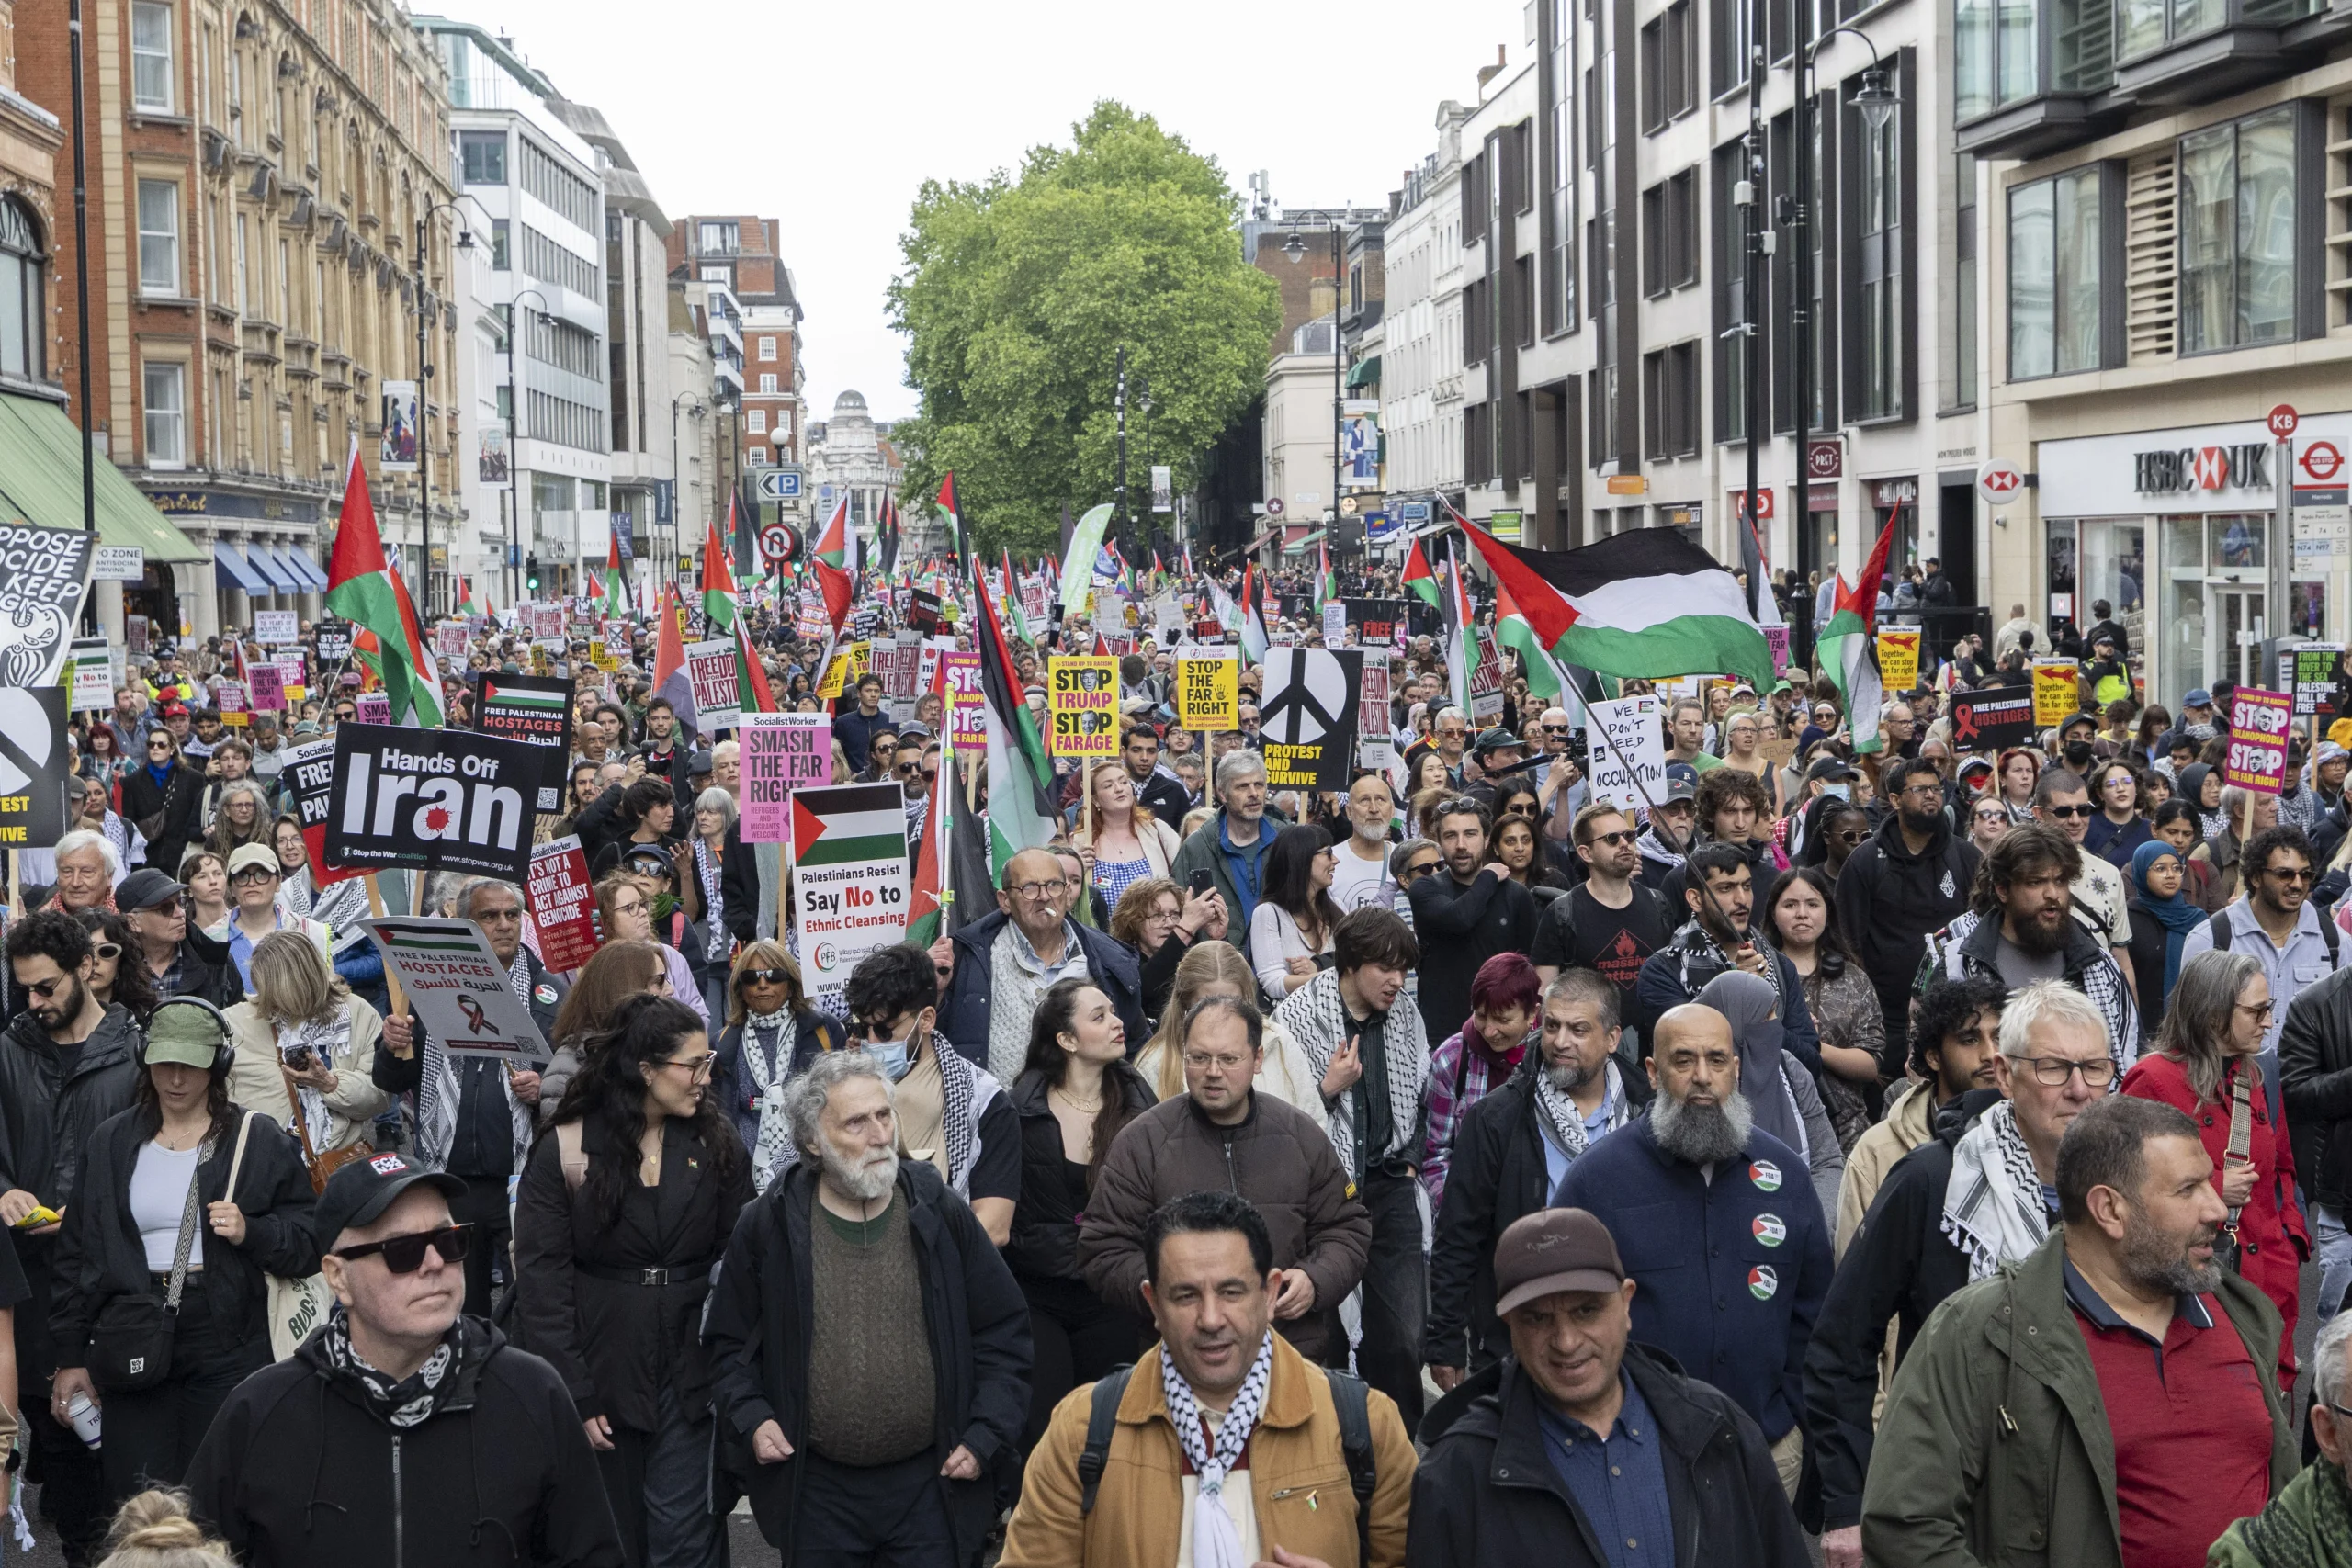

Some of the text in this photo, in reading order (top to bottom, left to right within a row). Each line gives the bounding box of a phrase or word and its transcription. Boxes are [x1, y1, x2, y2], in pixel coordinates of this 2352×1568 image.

[2272, 415, 2293, 429] KB
[1815, 454, 1833, 466] PRET
[2133, 443, 2272, 493] HSBC UK
[783, 476, 795, 492] P
[112, 550, 141, 558] ZONE
[0, 548, 77, 579] CIDE
[5, 571, 83, 604] KEEP
[535, 612, 561, 625] FREEDOM
[440, 627, 468, 641] FREEDOM
[535, 624, 562, 637] PALESTINE
[1363, 622, 1391, 637] FREE
[321, 634, 346, 642] STOP
[1363, 637, 1391, 645] PALESTINE
[1771, 640, 1786, 650] FAR
[439, 640, 467, 655] PALESTINE
[1882, 649, 1905, 659] Together
[895, 646, 919, 671] FREEDOM
[1902, 659, 1914, 667] stop
[2298, 652, 2336, 661] FROM THE
[1186, 660, 1223, 673] STOP
[1901, 667, 1914, 675] right
[2298, 662, 2333, 671] RIVER TO
[252, 670, 275, 678] SMASH
[1056, 669, 1112, 691] STP
[1187, 674, 1213, 687] THE
[2298, 672, 2328, 682] THE SEA
[254, 678, 280, 686] THE FAR
[893, 671, 919, 698] PALESTINE
[2039, 683, 2066, 693] Together
[2297, 682, 2338, 693] PALESTINE
[255, 687, 275, 696] RIGHT
[1187, 688, 1213, 701] FAR
[2063, 693, 2077, 701] stop
[2297, 693, 2327, 703] WILL BE
[1056, 692, 1112, 708] TRUMP
[1973, 698, 2030, 713] FREE PALESTINIAN
[2052, 700, 2061, 708] far
[2063, 700, 2078, 709] right
[2241, 693, 2255, 701] STAND
[2270, 697, 2290, 706] RACISM
[484, 707, 563, 720] FREE PALESTINIAN
[1187, 702, 1229, 715] RIGHT
[1614, 704, 1634, 718] WE
[2296, 704, 2315, 713] FREE
[483, 716, 562, 732] HOSTAGES
[1056, 712, 1113, 734] STP
[1973, 708, 2031, 727] HOSTAGES
[2233, 702, 2288, 733] STP
[1608, 719, 1645, 735] DON'T
[749, 730, 814, 753] SMASH
[962, 733, 977, 742] FAR
[1057, 735, 1113, 750] FARAGE
[2233, 728, 2284, 745] ISLAMOPHOBIA
[1264, 744, 1323, 759] PROTEST
[1761, 743, 1791, 758] JEWS
[381, 748, 499, 780] Hands Off
[1264, 758, 1290, 771] AND
[2230, 743, 2283, 774] STP
[749, 755, 823, 778] THE FAR
[1683, 772, 1691, 780] R
[2229, 770, 2279, 788] THE FAR RIGHT
[342, 752, 523, 851] Iran
[751, 807, 780, 815] REFUGEES
[353, 849, 427, 862] Stop the War coalition
[441, 854, 514, 873] www.stopwar.org.uk
[544, 854, 571, 874] NOT A
[801, 864, 900, 884] Palestinians Resist
[529, 871, 571, 896] CRIME TO
[534, 884, 589, 912] ACT AGAINST
[805, 885, 901, 915] Say No to
[538, 903, 582, 928] GENOCIDE
[806, 911, 905, 933] Ethnic Cleansing
[392, 951, 488, 964] FREE PALESTINIAN
[820, 952, 836, 964] PFB
[1598, 955, 1646, 969] massiv
[399, 961, 495, 977] HOSTAGES
[1606, 971, 1640, 982] ttac
[463, 978, 503, 992] الحرية
